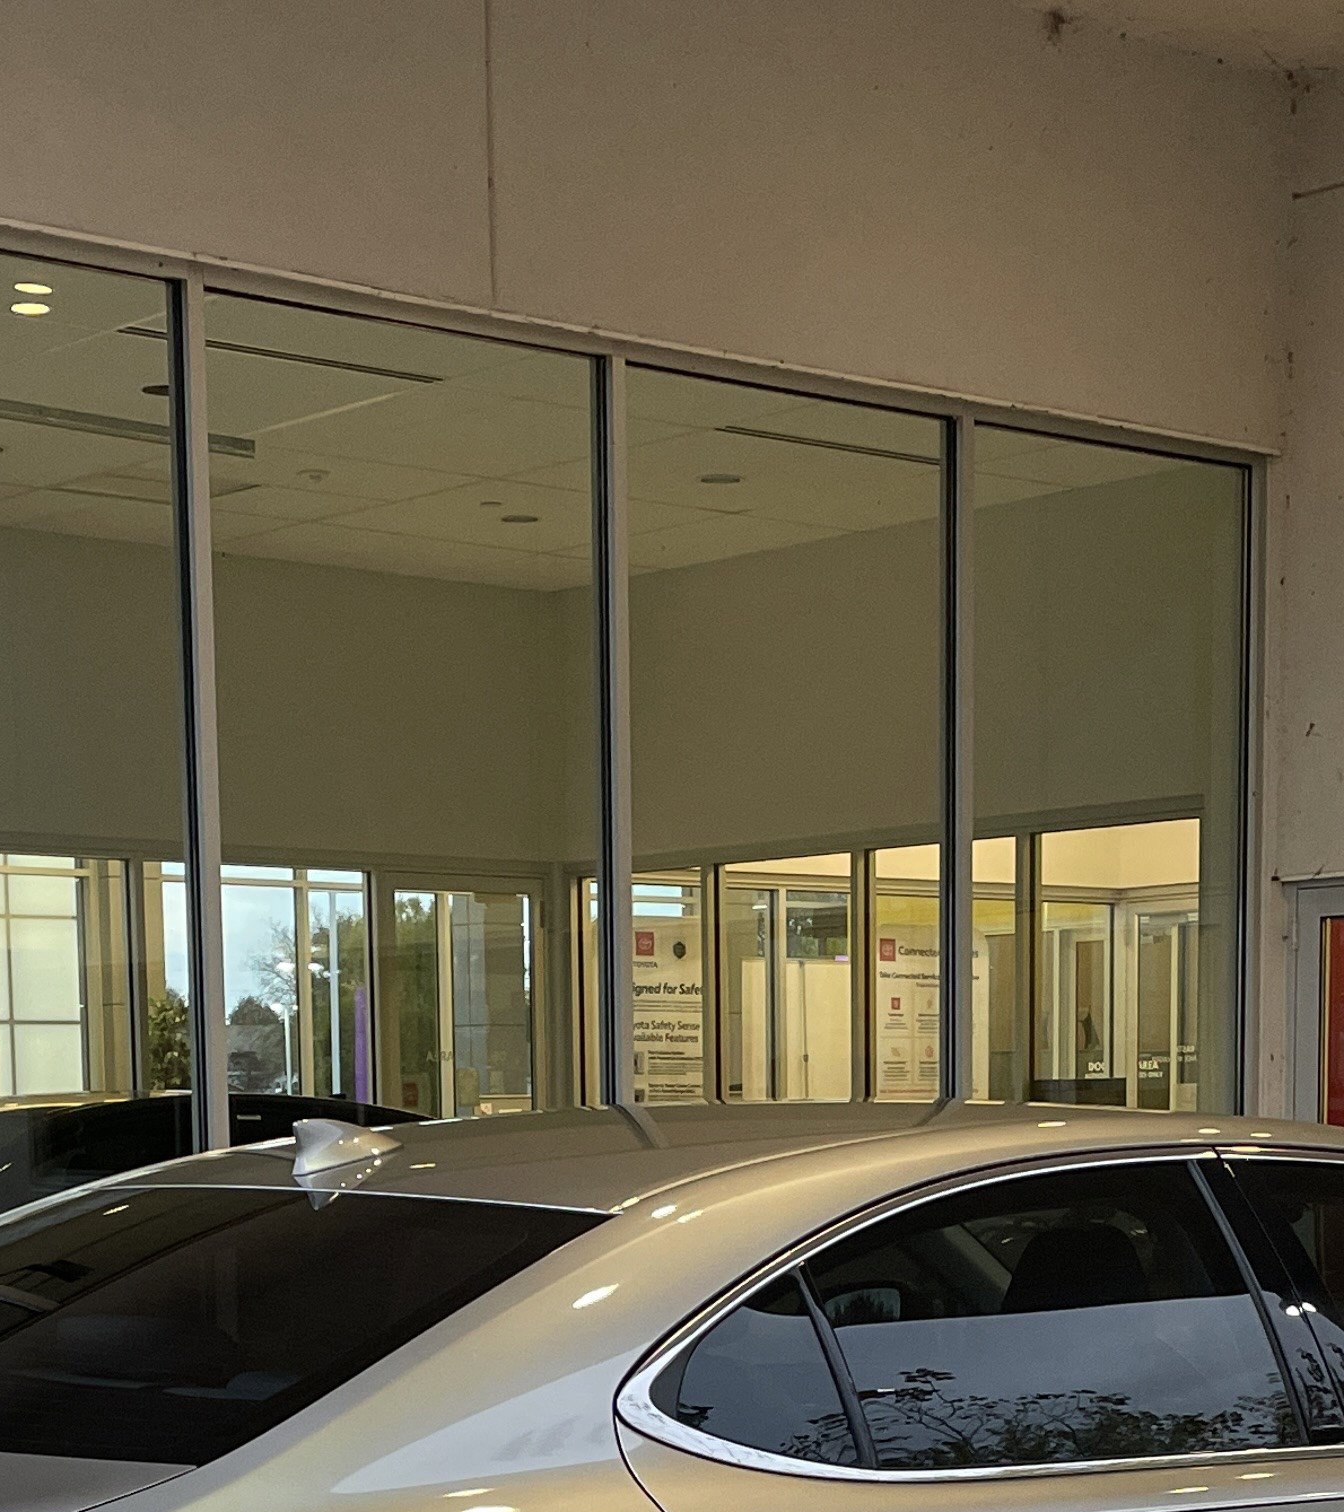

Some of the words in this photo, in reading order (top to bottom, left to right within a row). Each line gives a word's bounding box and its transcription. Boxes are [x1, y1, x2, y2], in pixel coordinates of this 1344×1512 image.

[633, 983, 661, 996] igned
[663, 982, 678, 994] for
[679, 983, 703, 995] Safe
[651, 1020, 676, 1032] Safety
